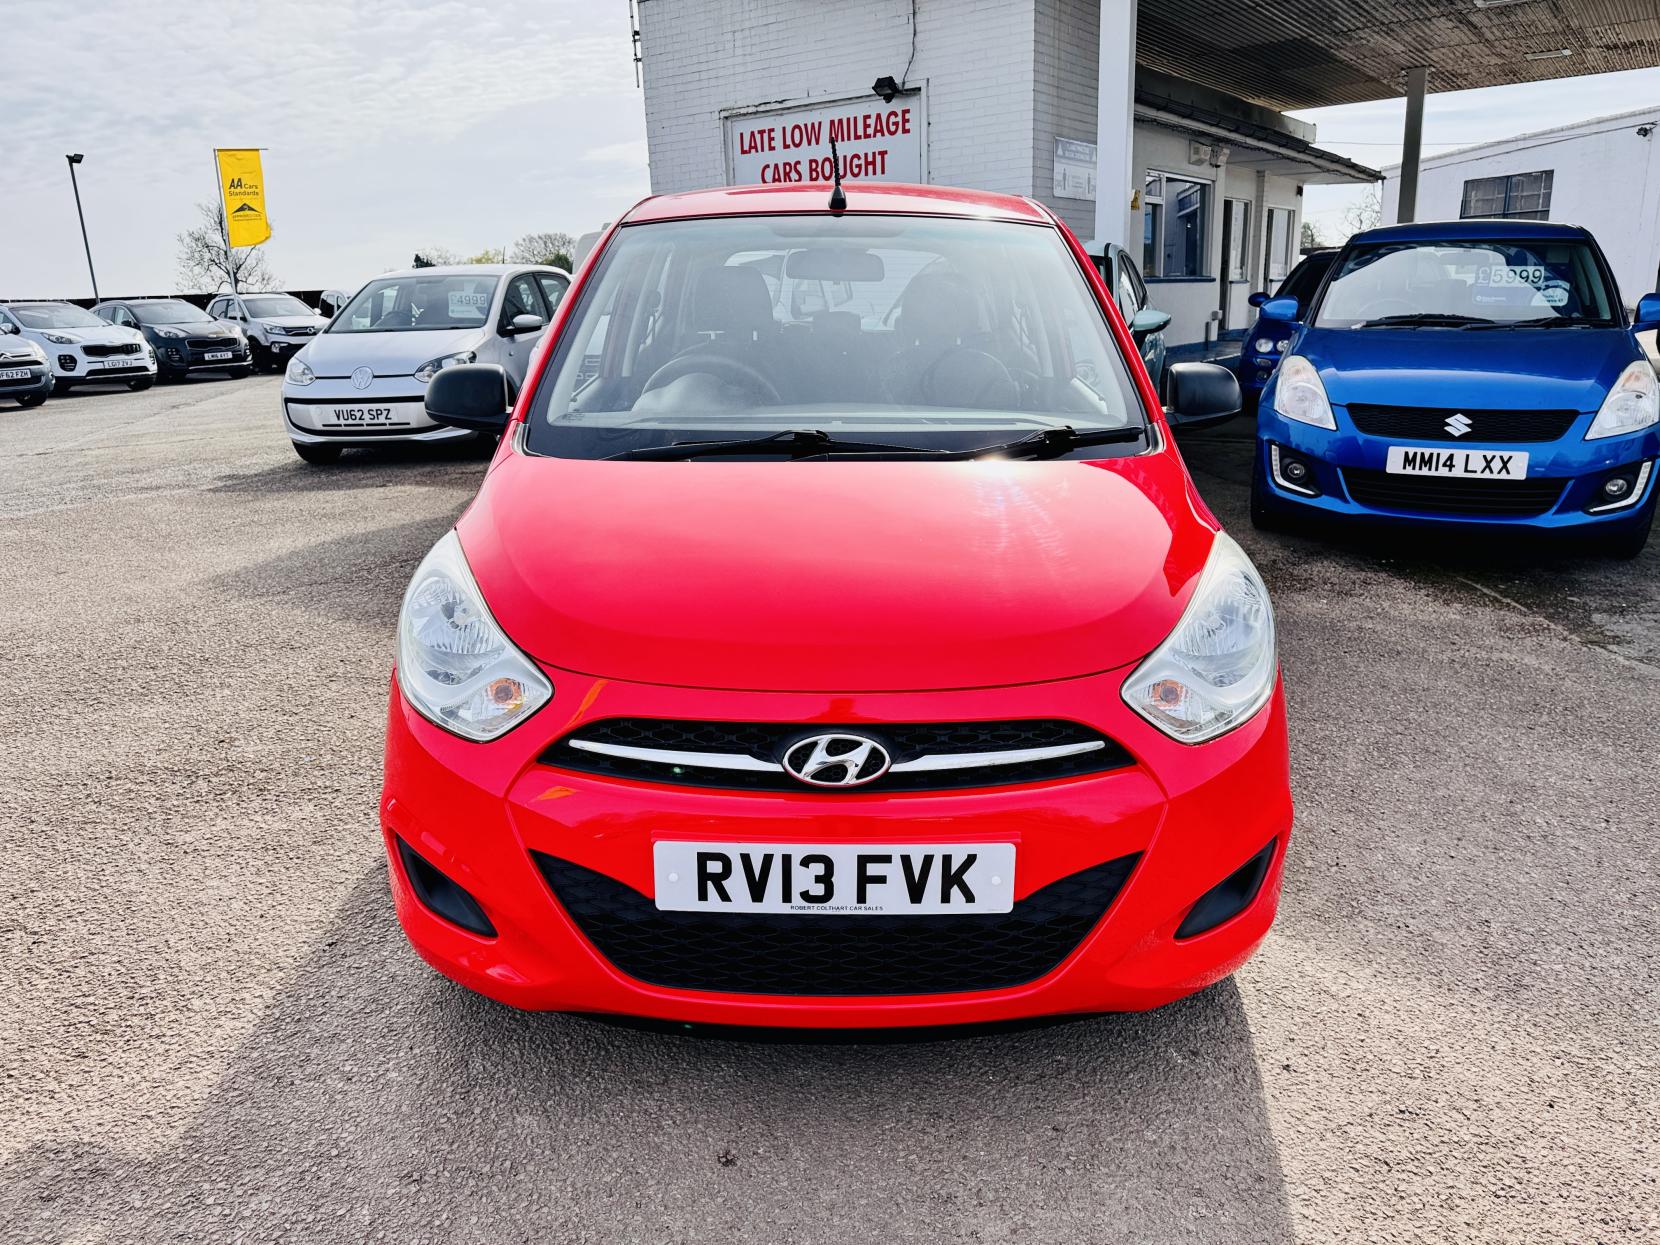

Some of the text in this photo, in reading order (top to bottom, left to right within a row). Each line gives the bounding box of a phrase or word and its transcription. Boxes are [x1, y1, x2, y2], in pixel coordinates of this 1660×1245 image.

[740, 109, 911, 155] LATE LOW MILEAGE
[760, 150, 888, 183] CARS BOUGHT
[229, 178, 243, 189] AA
[1478, 266, 1544, 285] £5999
[334, 408, 392, 421] VU62 SPZ
[1402, 450, 1513, 476] MM14 LXX
[696, 851, 978, 905] RV13 FVK
